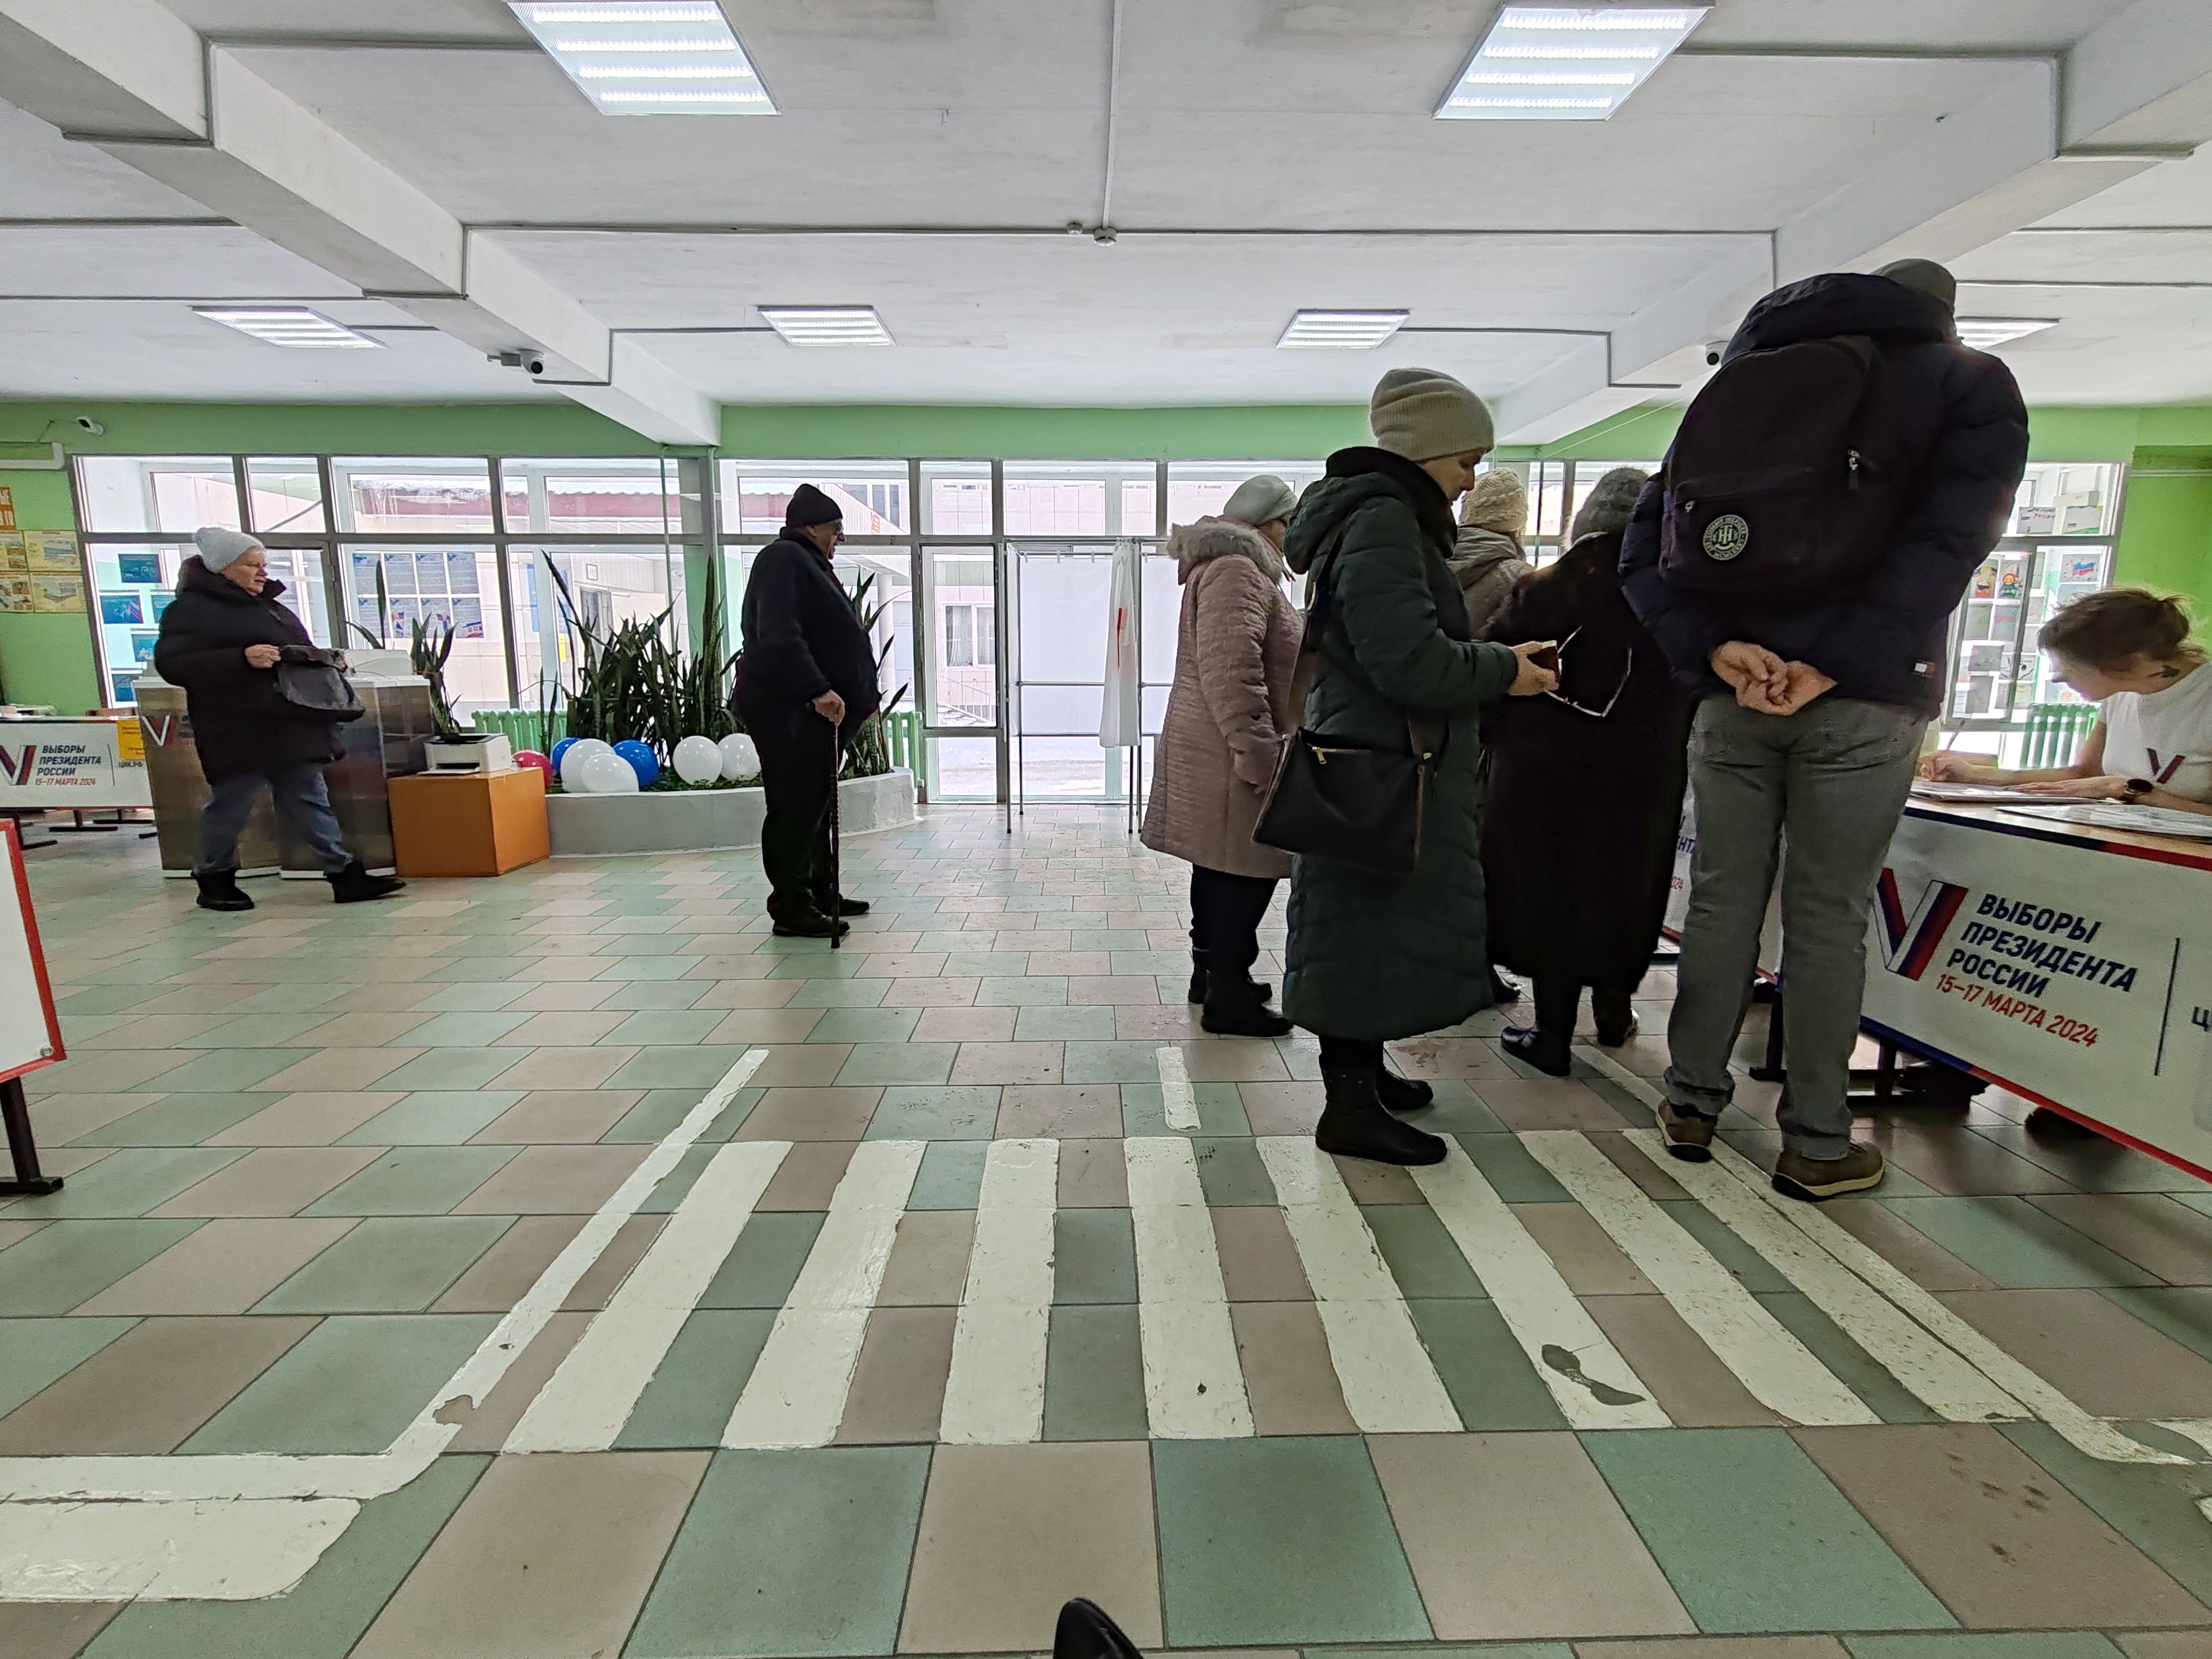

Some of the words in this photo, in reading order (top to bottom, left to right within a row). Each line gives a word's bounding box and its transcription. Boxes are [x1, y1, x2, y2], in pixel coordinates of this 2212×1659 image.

[36, 768, 76, 776] РОССИИ
[39, 756, 101, 766] ПРЕЗИДЕНТА
[42, 745, 86, 754] ВЫБОРЫ
[1977, 893, 2101, 943] ВЫБОРЫ
[1947, 948, 2050, 998] РОССИИ
[1960, 921, 2138, 992] ПРЕЗИДЕНТА
[1980, 990, 2047, 1027] МАРТА
[2046, 1015, 2100, 1047] 2024
